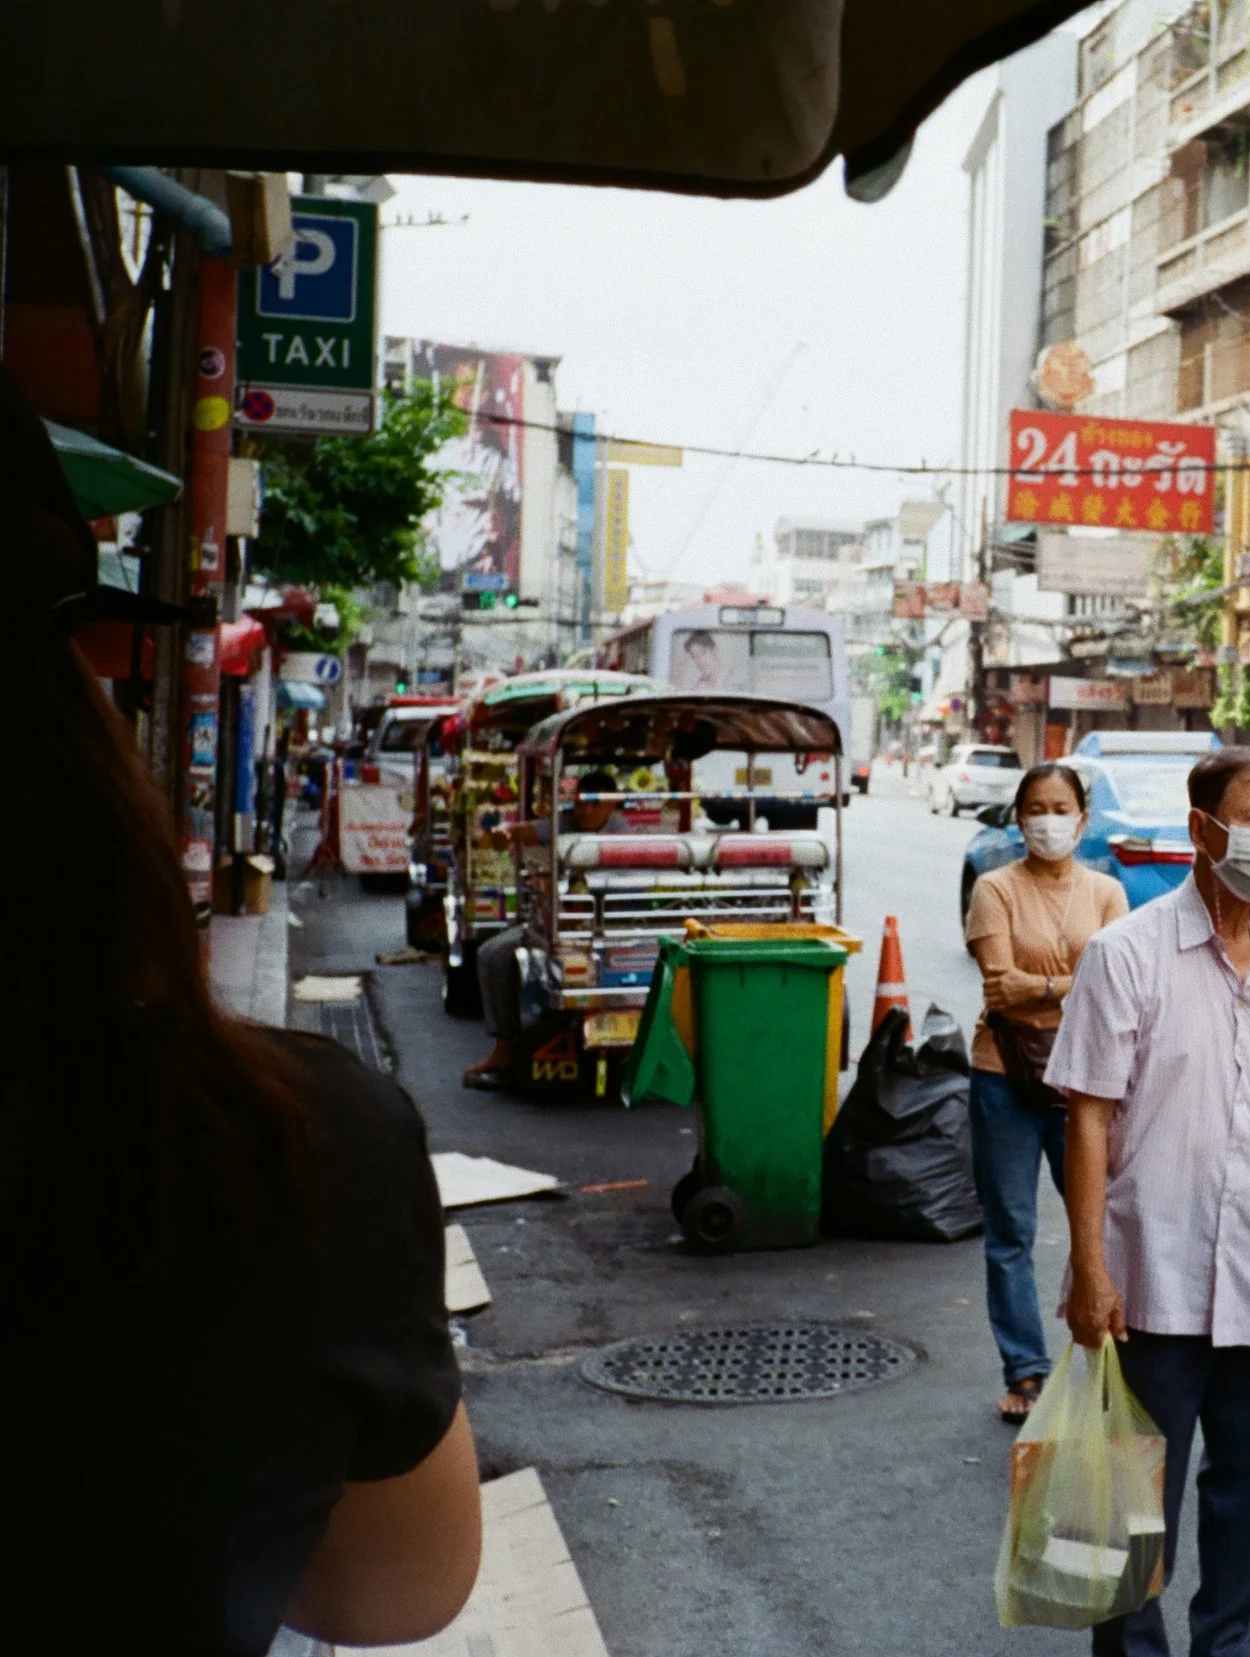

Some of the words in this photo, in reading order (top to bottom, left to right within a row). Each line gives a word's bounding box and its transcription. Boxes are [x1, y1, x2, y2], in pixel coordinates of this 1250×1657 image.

[277, 227, 337, 300] P
[261, 332, 350, 369] TAXI
[1014, 427, 1080, 488] 24
[1088, 439, 1207, 495] กะรัต
